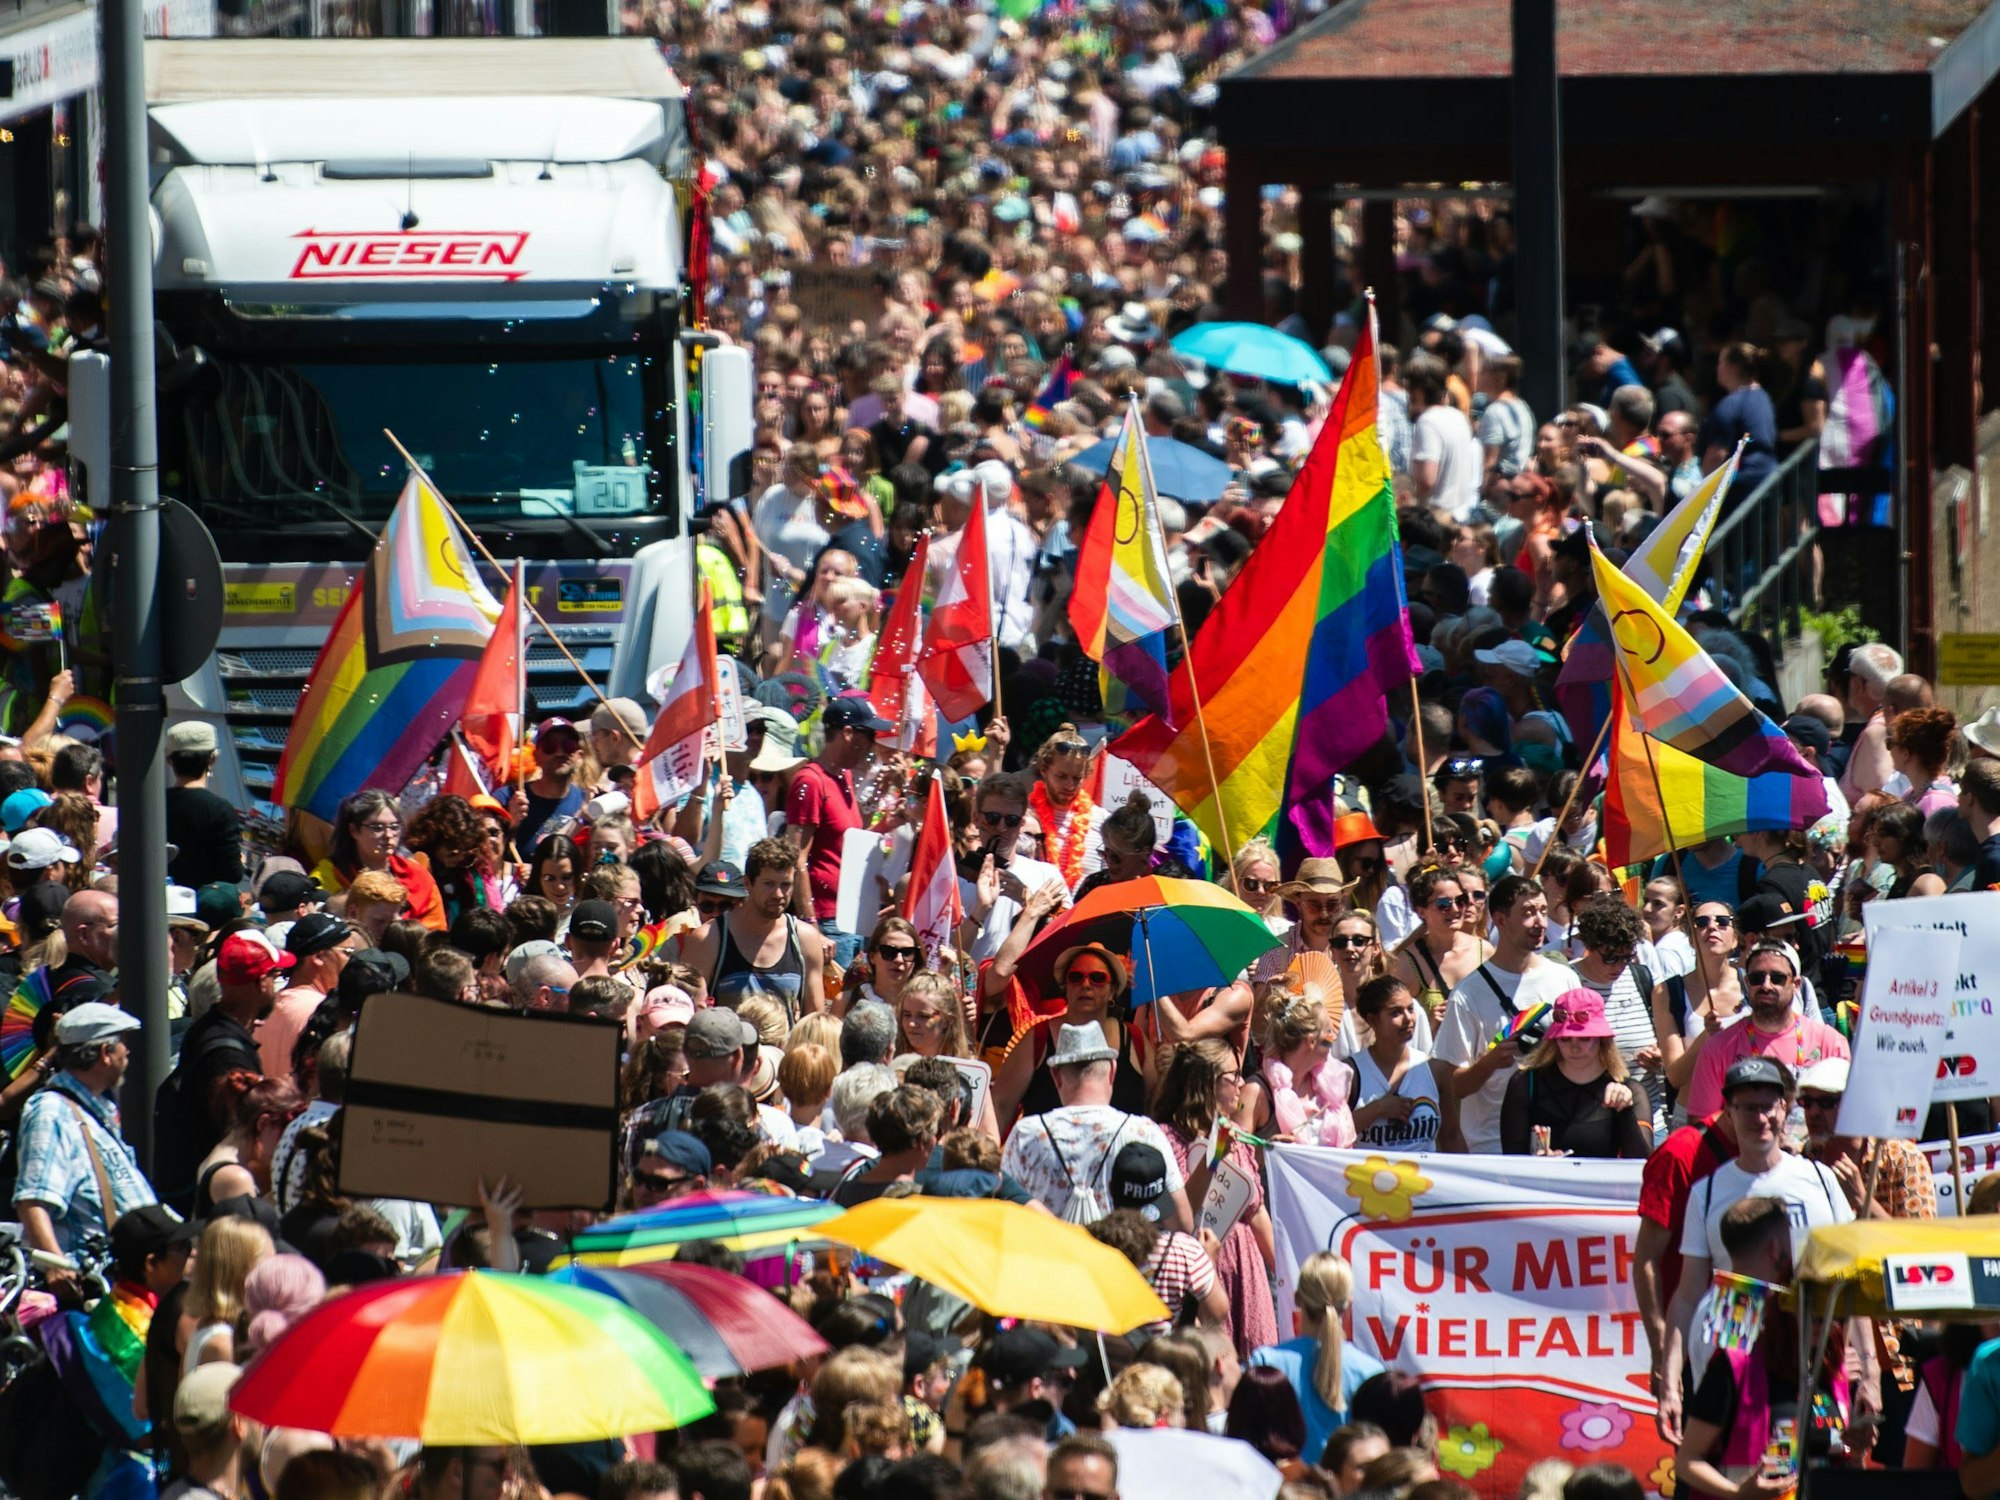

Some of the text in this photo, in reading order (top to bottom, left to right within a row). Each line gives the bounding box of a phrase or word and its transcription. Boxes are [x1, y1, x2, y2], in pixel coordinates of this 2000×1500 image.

[290, 235, 530, 275] NIESEN
[593, 481, 628, 509] 20
[1123, 772, 1156, 788] LIEB
[1888, 976, 1938, 998] Artikel 3
[1876, 1031, 1896, 1053] Wir
[1123, 1177, 1164, 1198] PRIDE
[1369, 1235, 1636, 1294] FÜR MEH
[1895, 1265, 1954, 1284] LSVD
